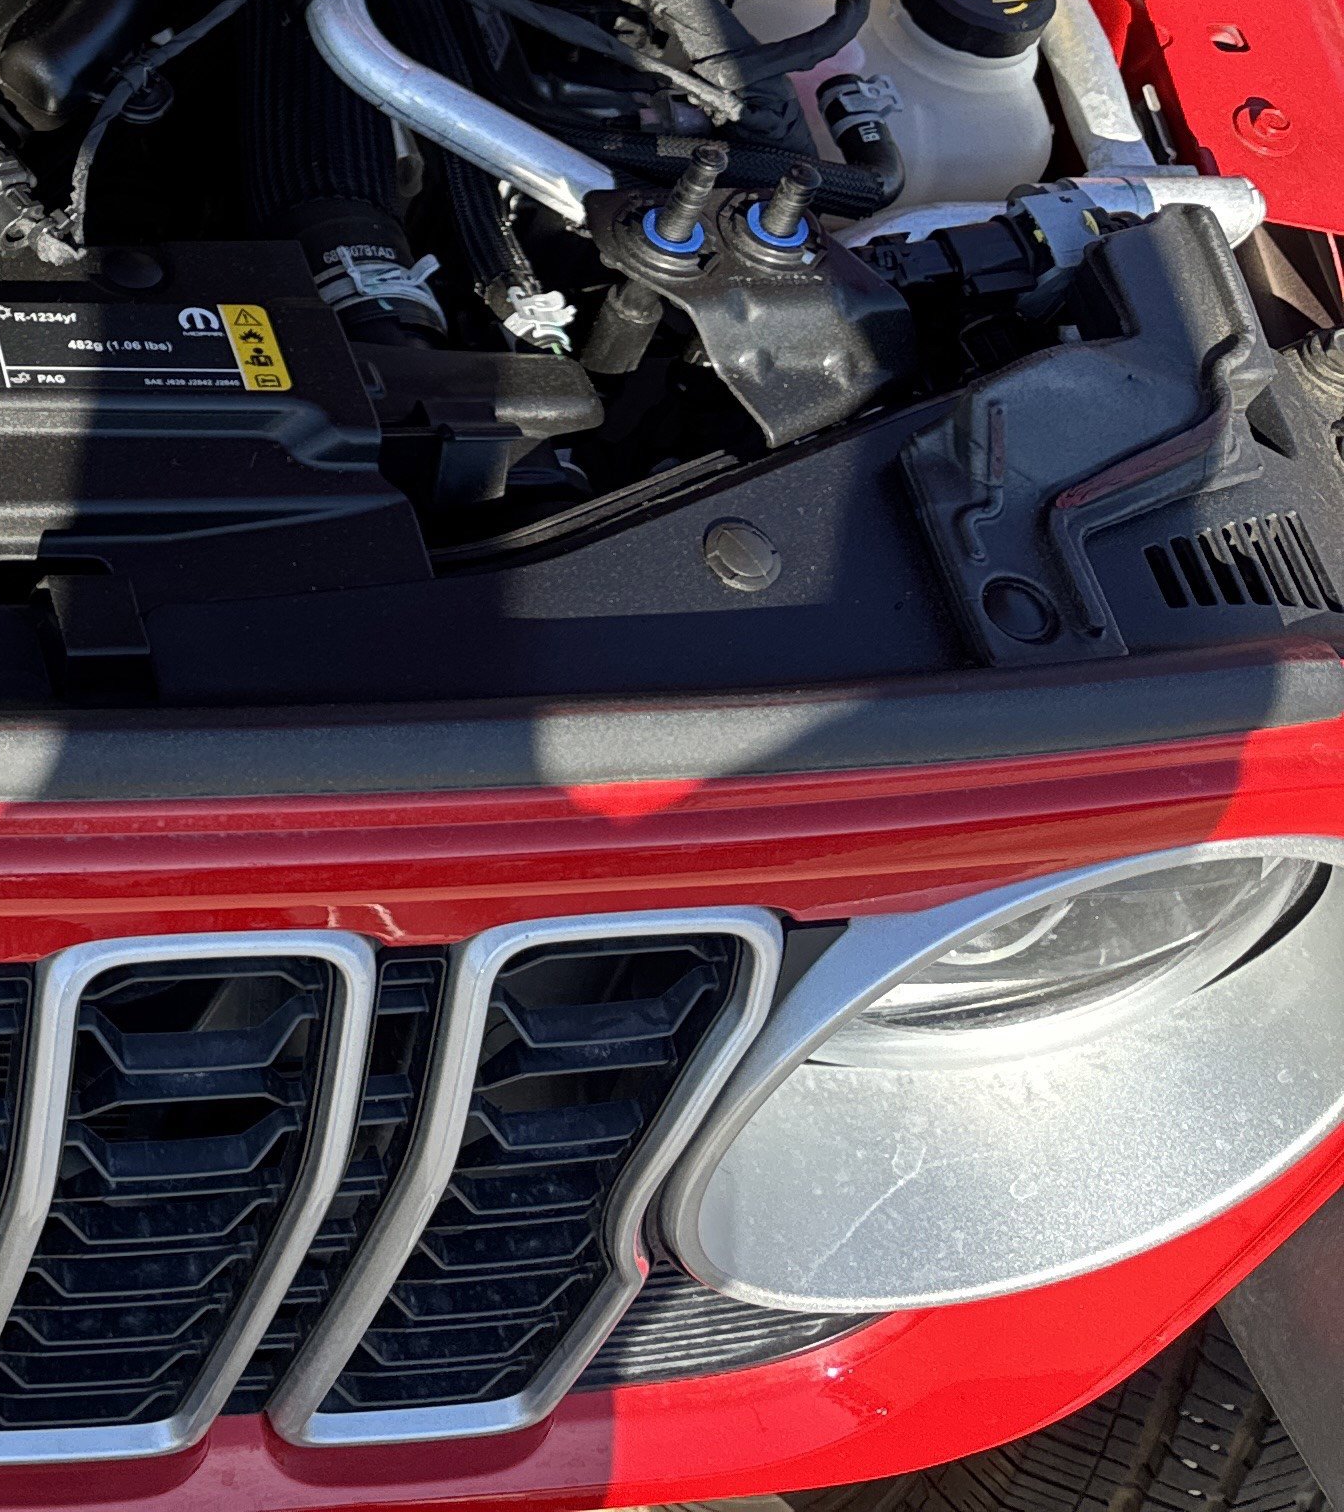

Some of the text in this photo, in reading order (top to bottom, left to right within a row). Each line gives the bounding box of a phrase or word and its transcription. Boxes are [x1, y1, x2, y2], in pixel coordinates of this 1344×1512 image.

[14, 312, 77, 325] R-1234yf
[67, 339, 173, 353] 482g (1.06 lbs)
[37, 374, 66, 384] PAG
